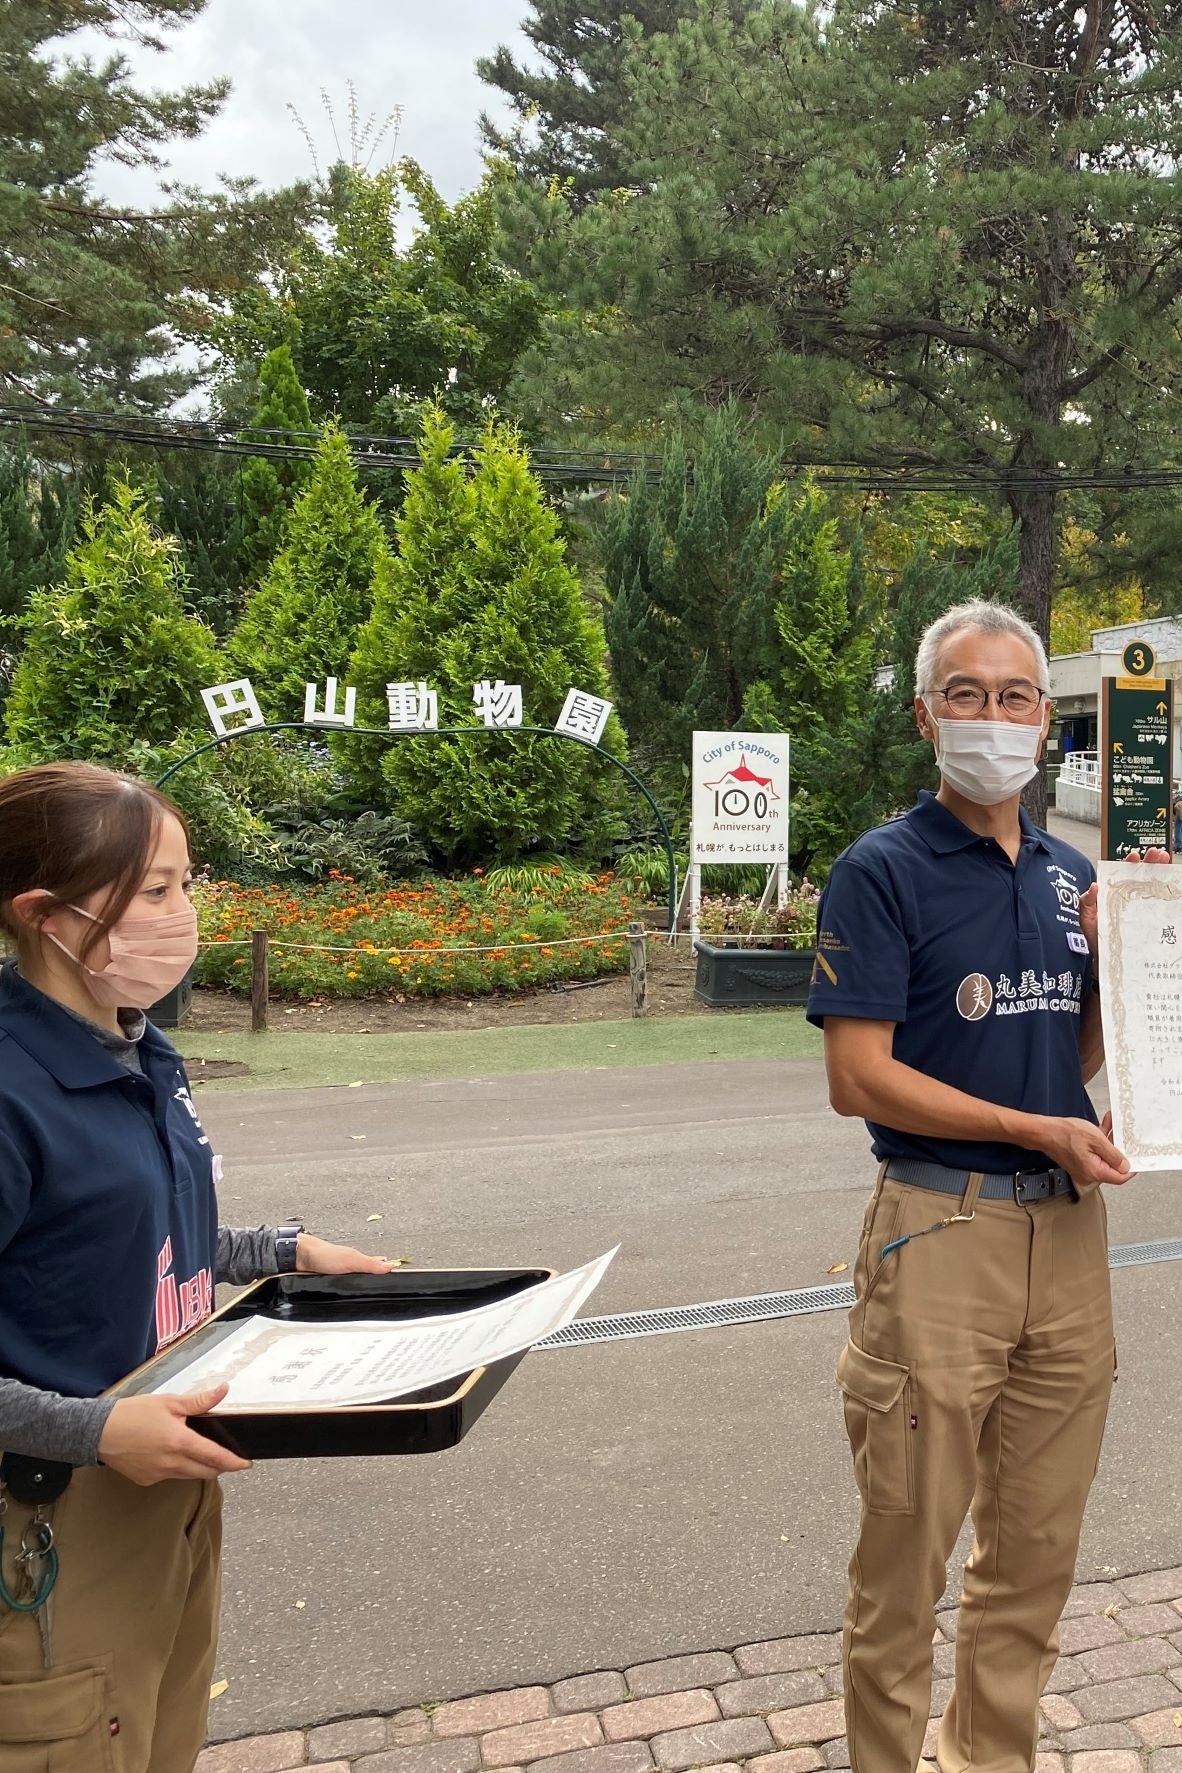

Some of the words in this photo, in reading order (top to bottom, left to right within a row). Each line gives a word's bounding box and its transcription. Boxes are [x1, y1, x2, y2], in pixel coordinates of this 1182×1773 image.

[1132, 649, 1145, 670] 3
[200, 676, 614, 747] 円山動物園
[1147, 716, 1167, 724] サル山
[703, 746, 722, 764] City
[724, 740, 736, 752] of
[738, 740, 780, 765] Sapporo
[712, 822, 770, 832] Anniversary
